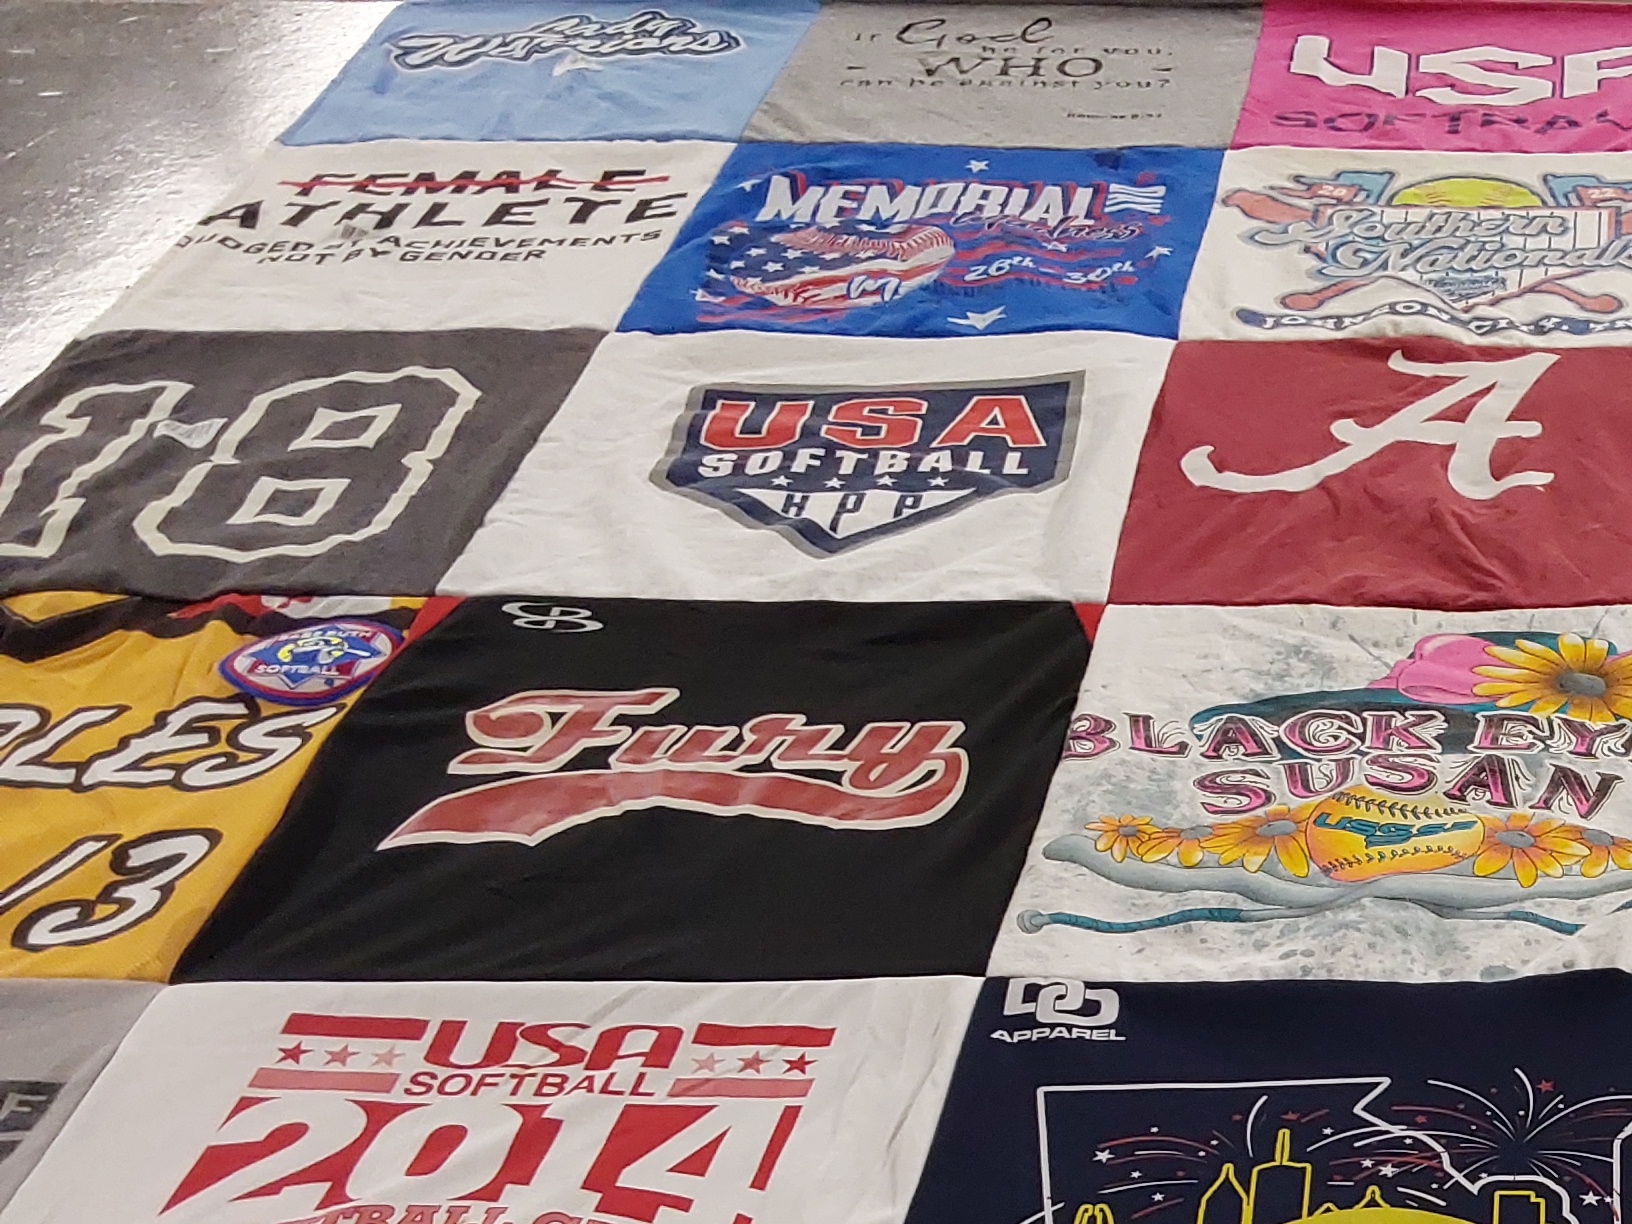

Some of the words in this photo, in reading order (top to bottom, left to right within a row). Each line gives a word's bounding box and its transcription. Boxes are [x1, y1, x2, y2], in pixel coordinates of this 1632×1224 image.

[918, 57, 1104, 77] WHO
[294, 168, 648, 198] FEMALE
[755, 175, 1098, 225] MEMORIAL
[198, 192, 689, 231] ATHLETE
[1252, 207, 1570, 246] Southern
[256, 251, 338, 266] NOT
[399, 248, 549, 263] GENDER
[376, 228, 663, 251] ACHIEVEMENTS
[700, 394, 1047, 451] USA
[1180, 349, 1563, 501] A
[0, 364, 483, 565] 18
[697, 447, 1030, 479] SOFTBALL
[254, 663, 341, 677] SOFTBALL
[446, 687, 970, 802] Fury
[1061, 708, 1433, 764] BLACK
[1192, 752, 1628, 822] SUSAN
[421, 1019, 687, 1072] USA
[990, 1025, 1127, 1043] APPAREL
[401, 1068, 661, 1099] SOFTBALL
